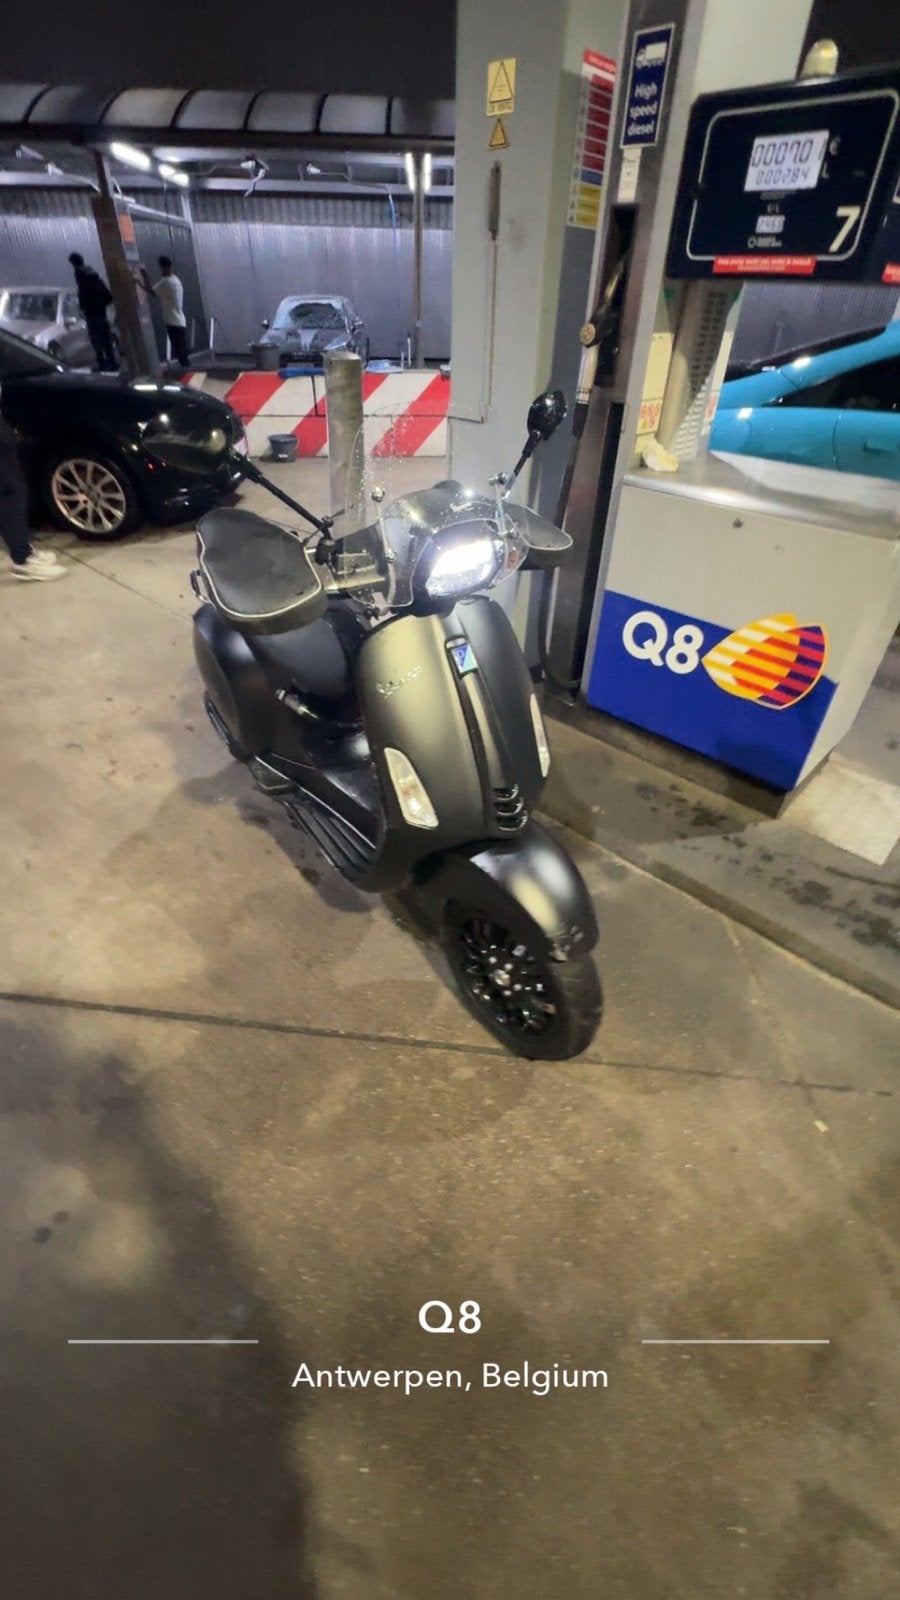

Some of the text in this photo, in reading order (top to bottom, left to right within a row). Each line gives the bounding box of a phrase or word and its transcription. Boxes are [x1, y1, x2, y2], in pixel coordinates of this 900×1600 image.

[634, 82, 658, 100] High
[629, 101, 658, 119] speed
[627, 120, 655, 137] diesel
[829, 206, 861, 252] 7
[622, 611, 704, 674] Q8
